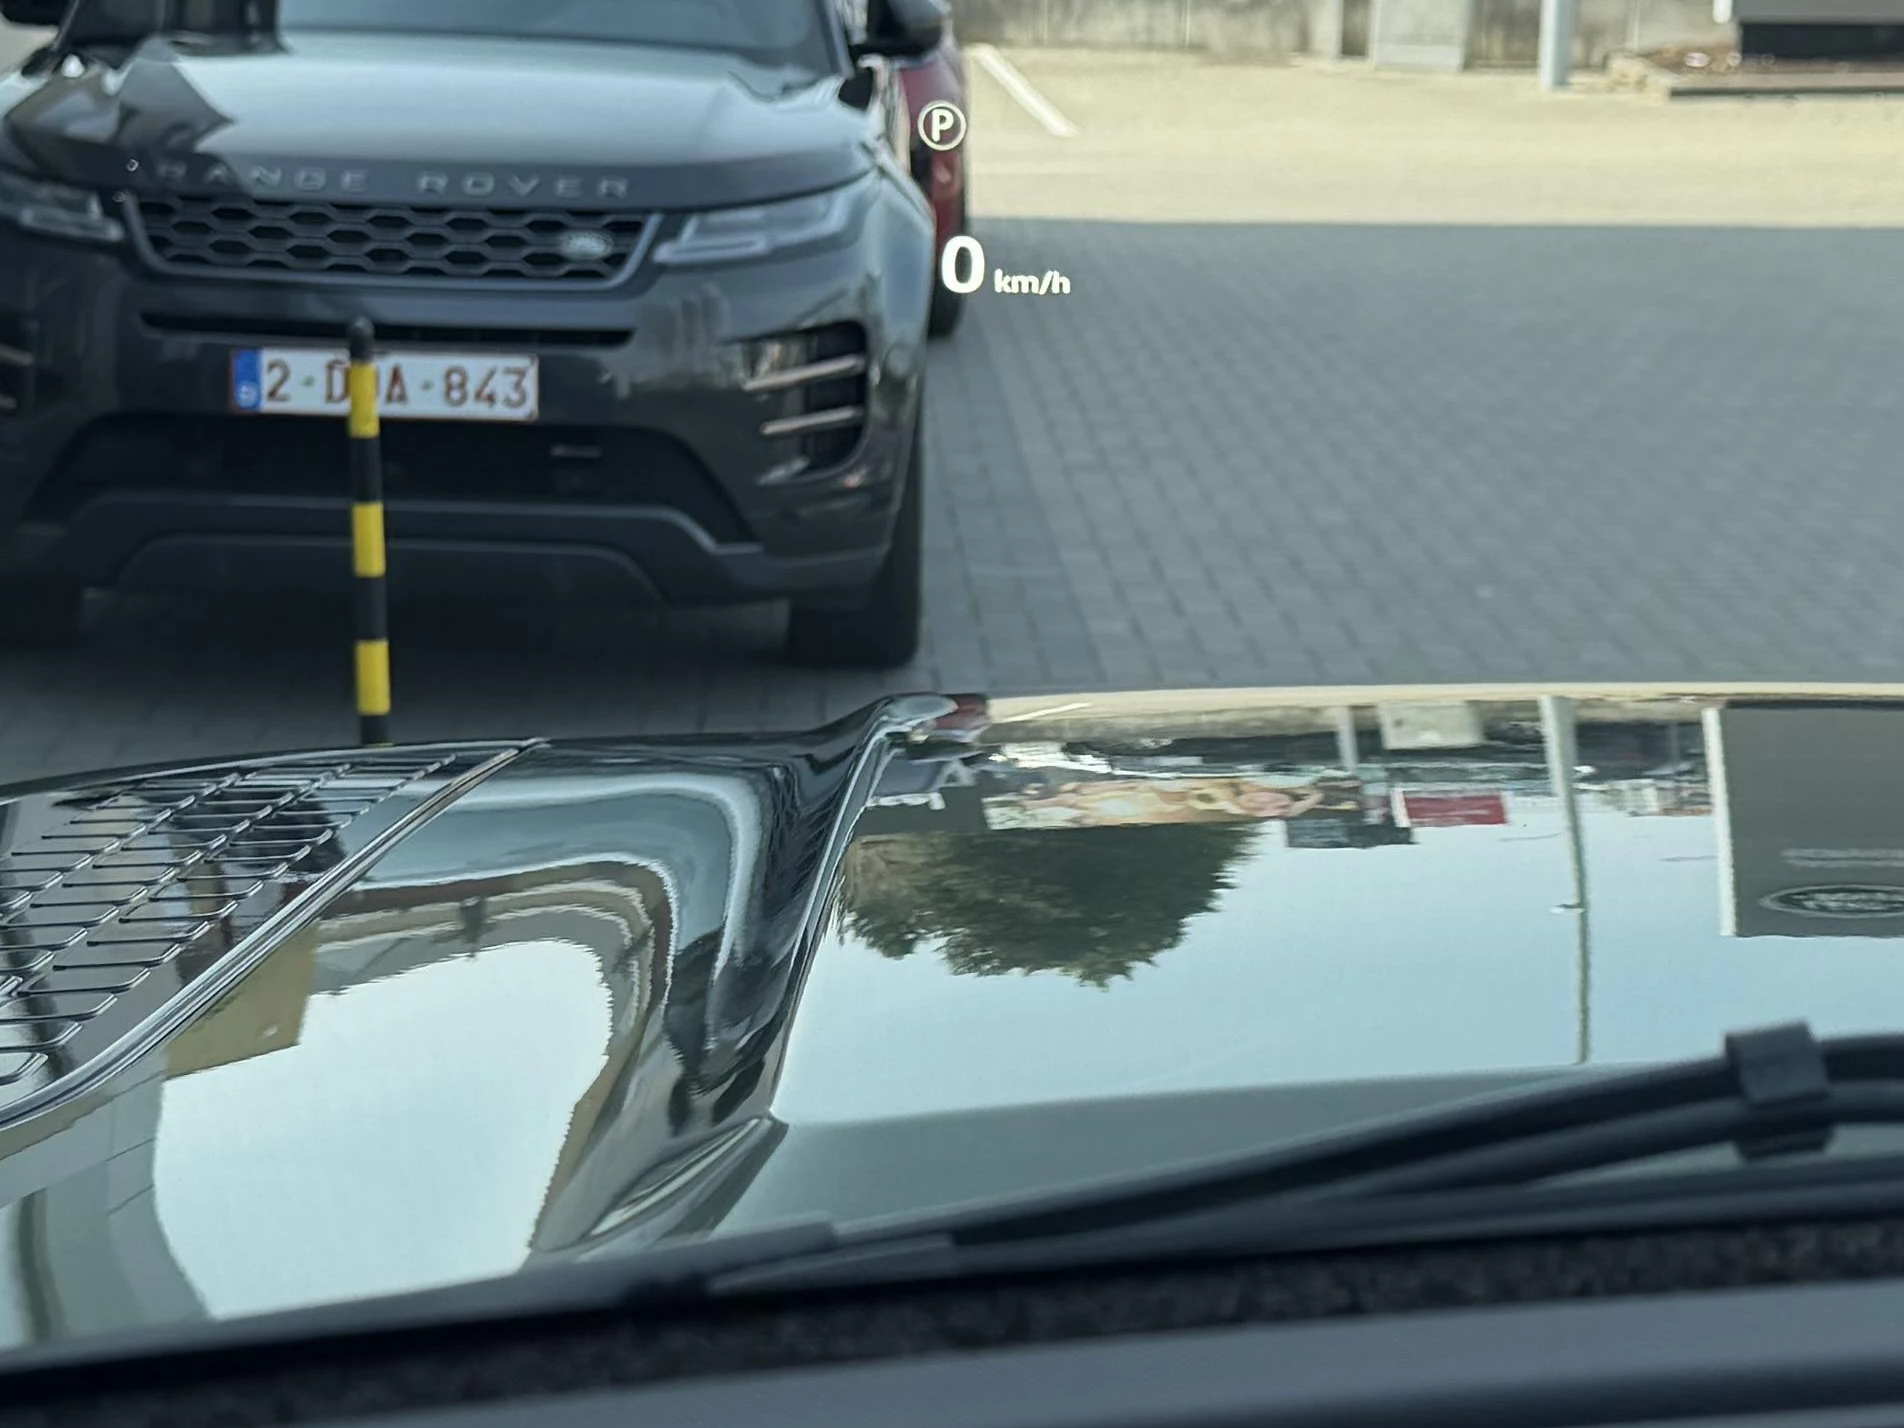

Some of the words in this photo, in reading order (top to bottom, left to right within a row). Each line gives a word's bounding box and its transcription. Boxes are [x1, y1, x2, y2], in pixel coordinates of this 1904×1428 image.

[417, 173, 630, 198] ROVER
[941, 236, 985, 294] 0
[994, 268, 1071, 296] km/h
[266, 358, 528, 409] 2-DA-843
